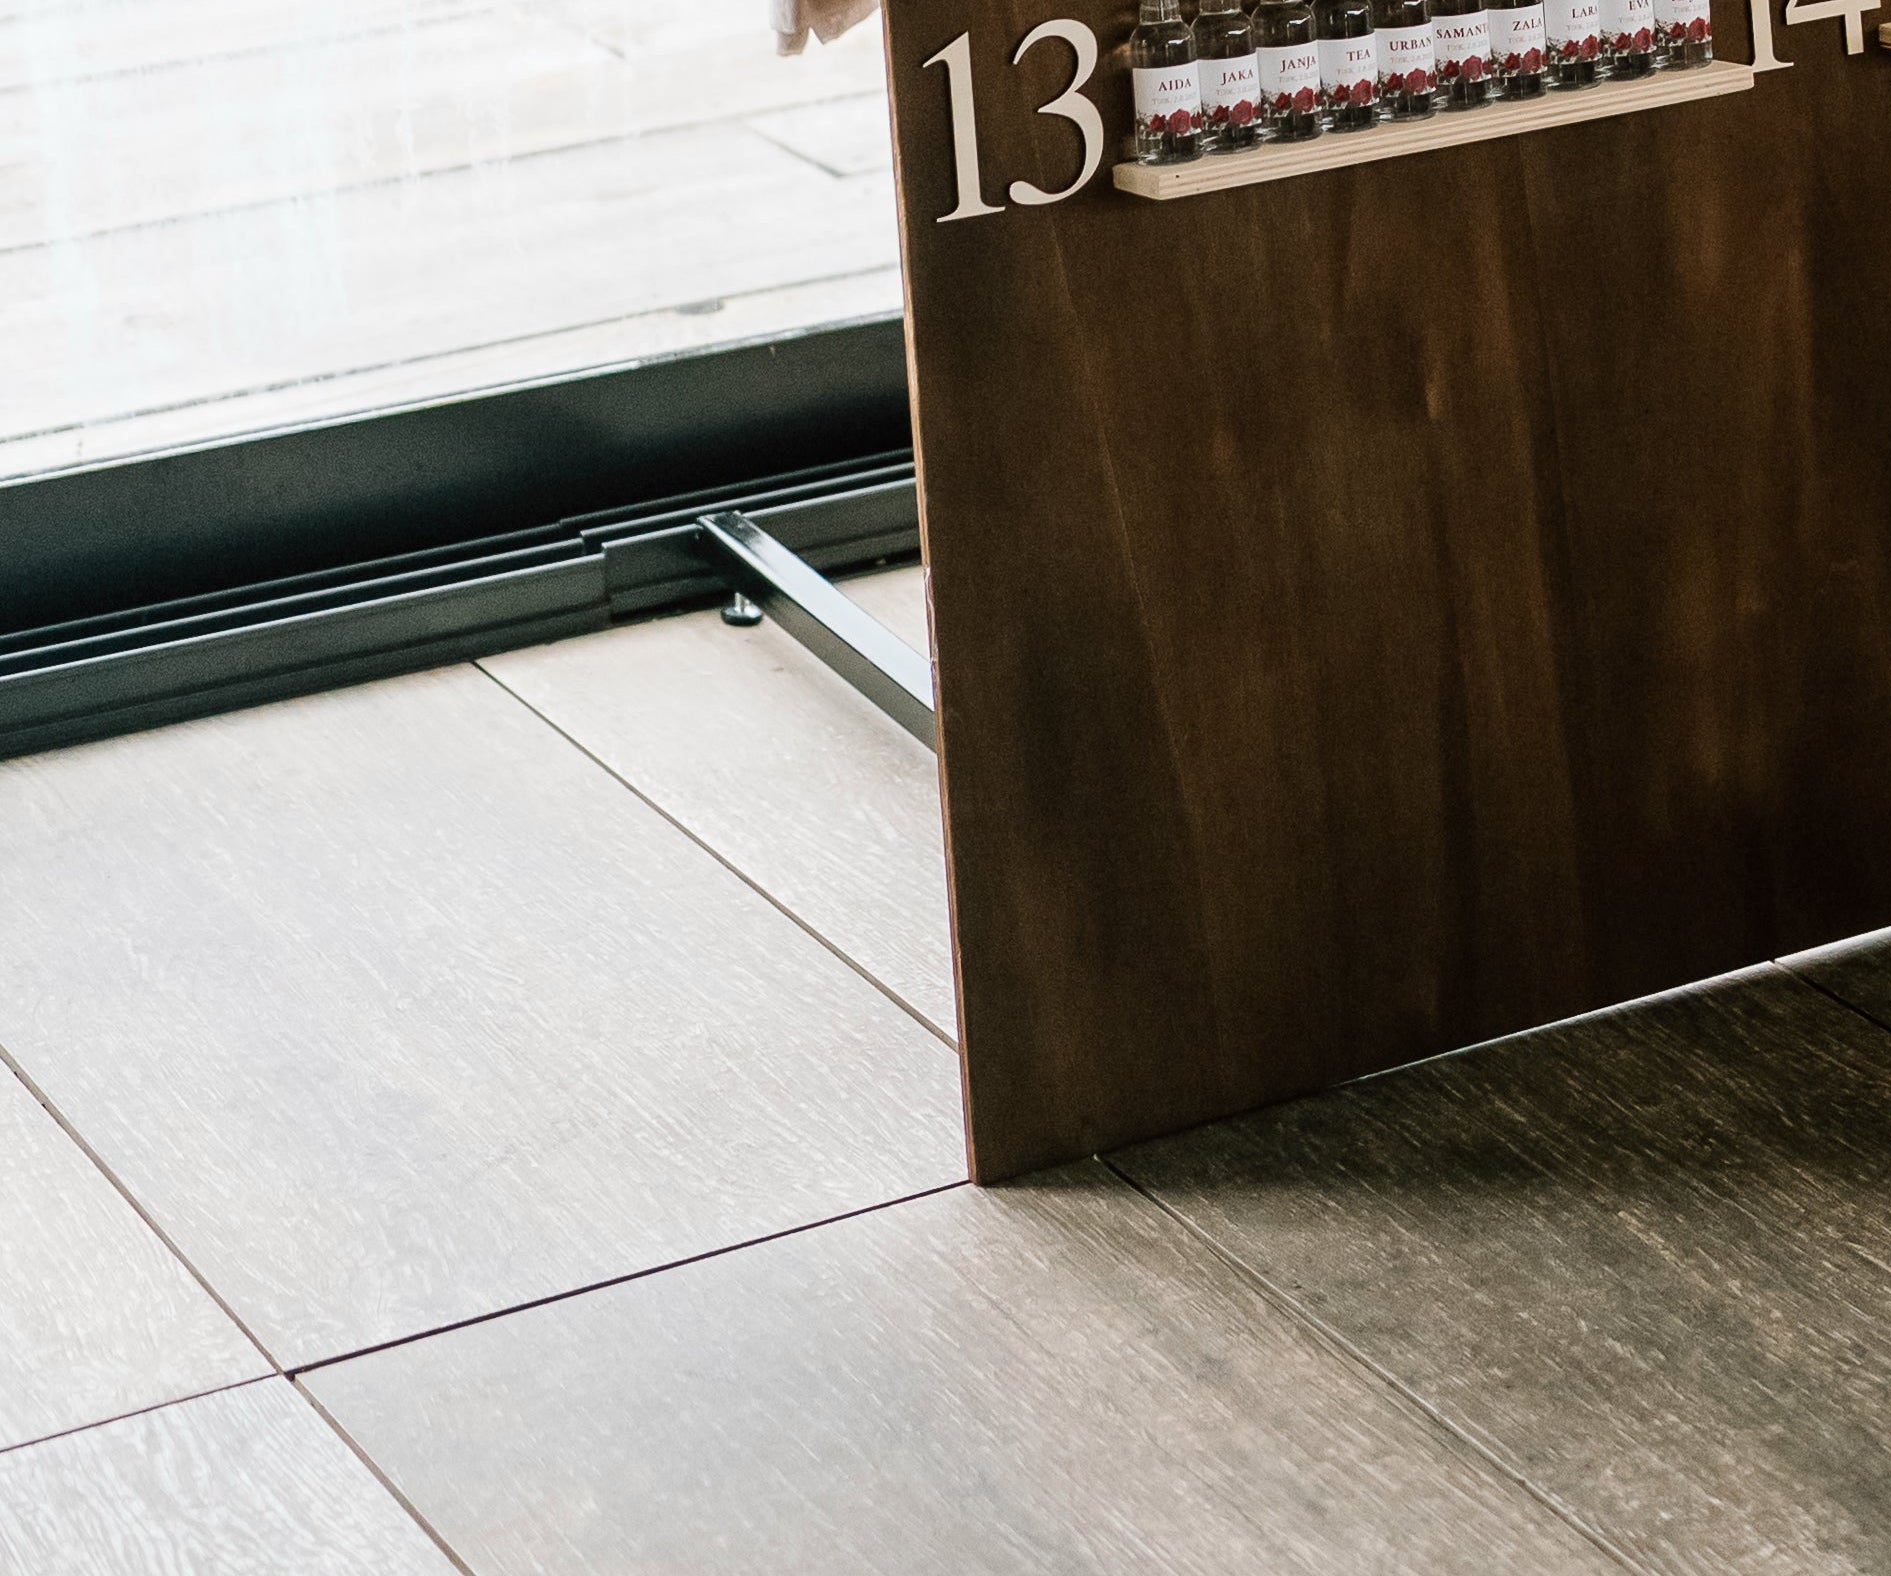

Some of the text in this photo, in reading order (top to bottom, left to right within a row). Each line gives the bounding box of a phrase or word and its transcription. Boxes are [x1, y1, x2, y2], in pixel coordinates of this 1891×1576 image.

[1280, 55, 1317, 73] JANJA
[1346, 49, 1371, 62] TEA
[1158, 77, 1192, 92] AIDA
[1221, 68, 1254, 86] JAKA
[923, 18, 1104, 223] 13
